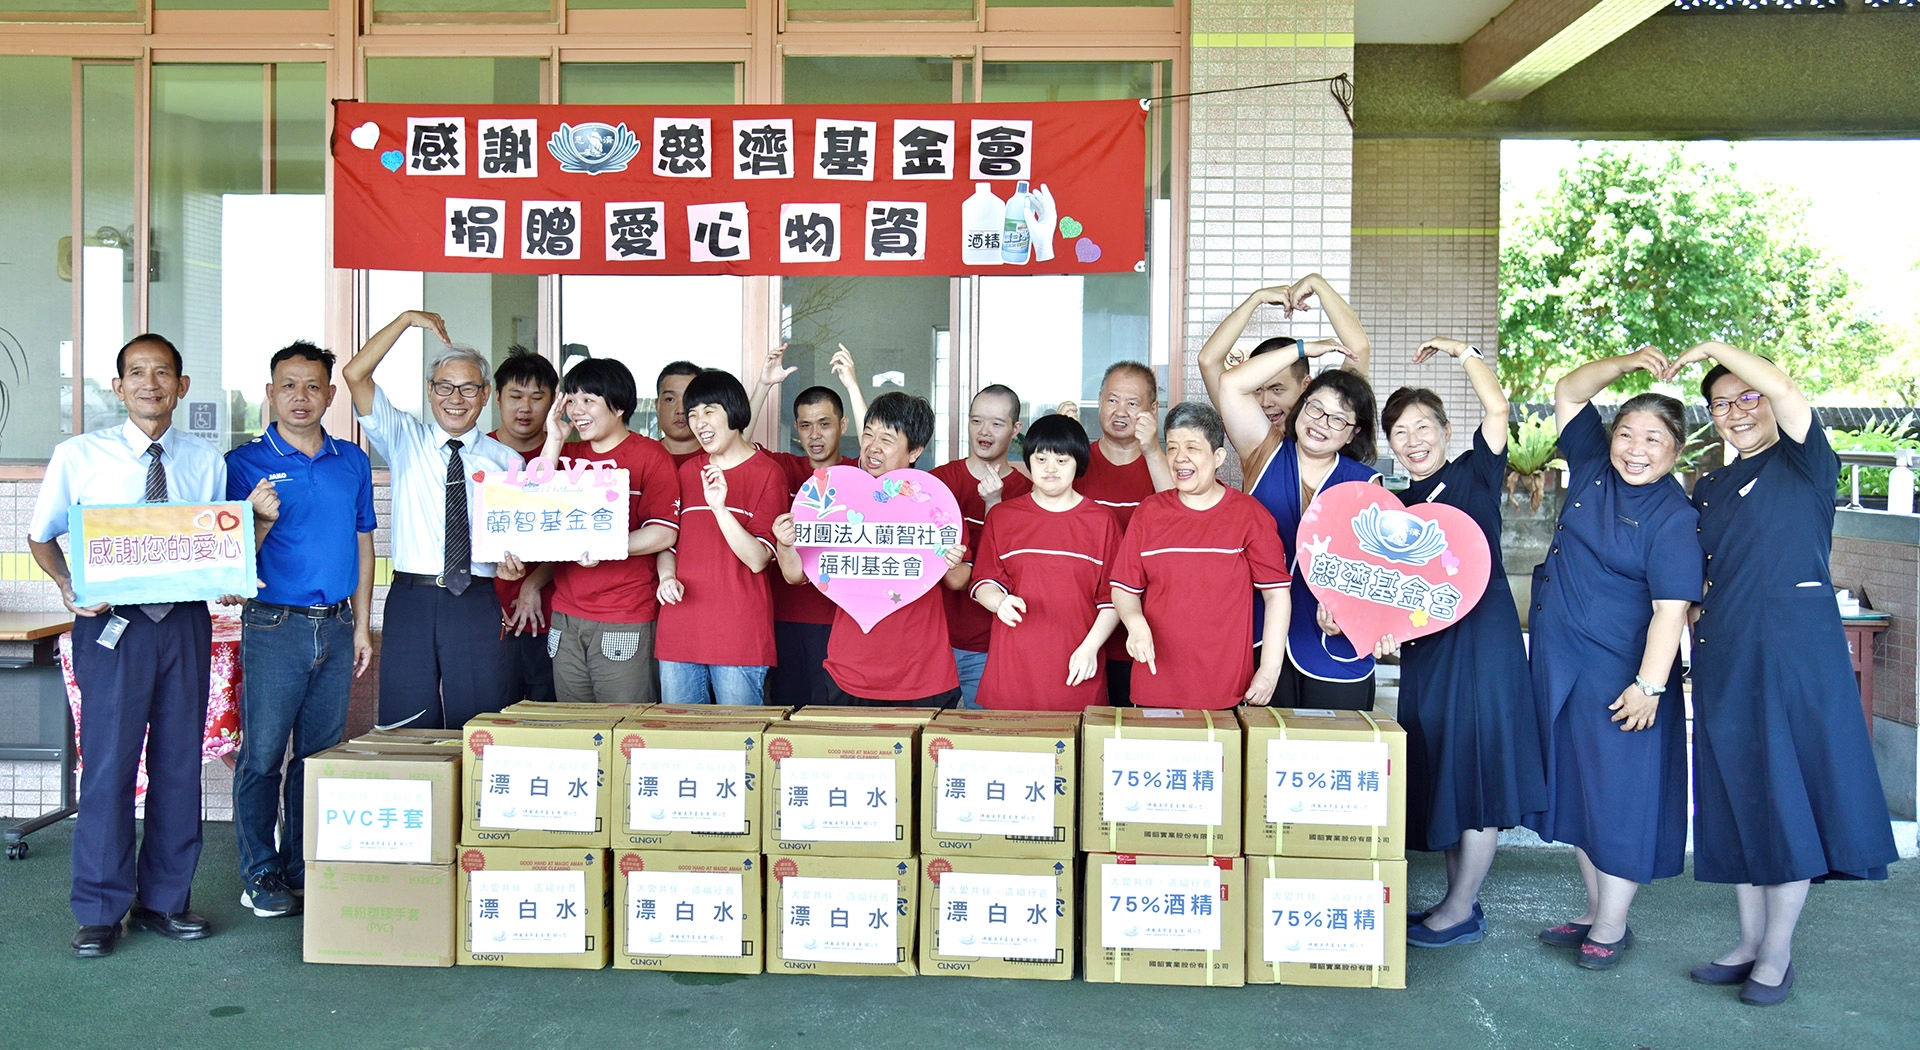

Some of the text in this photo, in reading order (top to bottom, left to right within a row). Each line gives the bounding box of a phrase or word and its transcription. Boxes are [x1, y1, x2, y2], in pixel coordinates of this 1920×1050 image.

[411, 122, 1026, 176] 感謝 慈濟基金會
[450, 205, 919, 258] 捐贈愛心物資
[968, 233, 1000, 248] 酒精
[504, 456, 618, 488] LOVE
[487, 507, 614, 533] 蘭智基金會
[794, 523, 958, 545] 財團法人蘭智社會
[88, 532, 242, 565] 感謝您的愛心
[820, 554, 922, 577] 福利基金會
[1309, 552, 1462, 620] 慈濟基金會
[489, 773, 589, 798] 漂白水
[637, 776, 737, 799] 漂白水
[945, 777, 1046, 802] 漂白水
[1112, 769, 1215, 792] 75%酒精
[1275, 769, 1380, 792] 75%酒精
[788, 786, 888, 808] 漂白水
[478, 832, 510, 840] CLNGV1
[629, 836, 662, 844] CLNGV1
[939, 841, 972, 849] CLNGV1
[479, 898, 577, 920] 漂白水
[636, 899, 734, 922] 漂白水
[947, 900, 1048, 925] 漂白水
[1110, 893, 1213, 916] 75%酒精
[366, 923, 394, 934] (PVC)
[790, 905, 889, 929] 漂白水
[1272, 908, 1375, 931] 75%酒精
[472, 954, 504, 962] CLNGV1
[630, 958, 662, 966] CLNGV1
[784, 961, 816, 969] CLNGV1
[938, 962, 970, 970] CLNGV1
